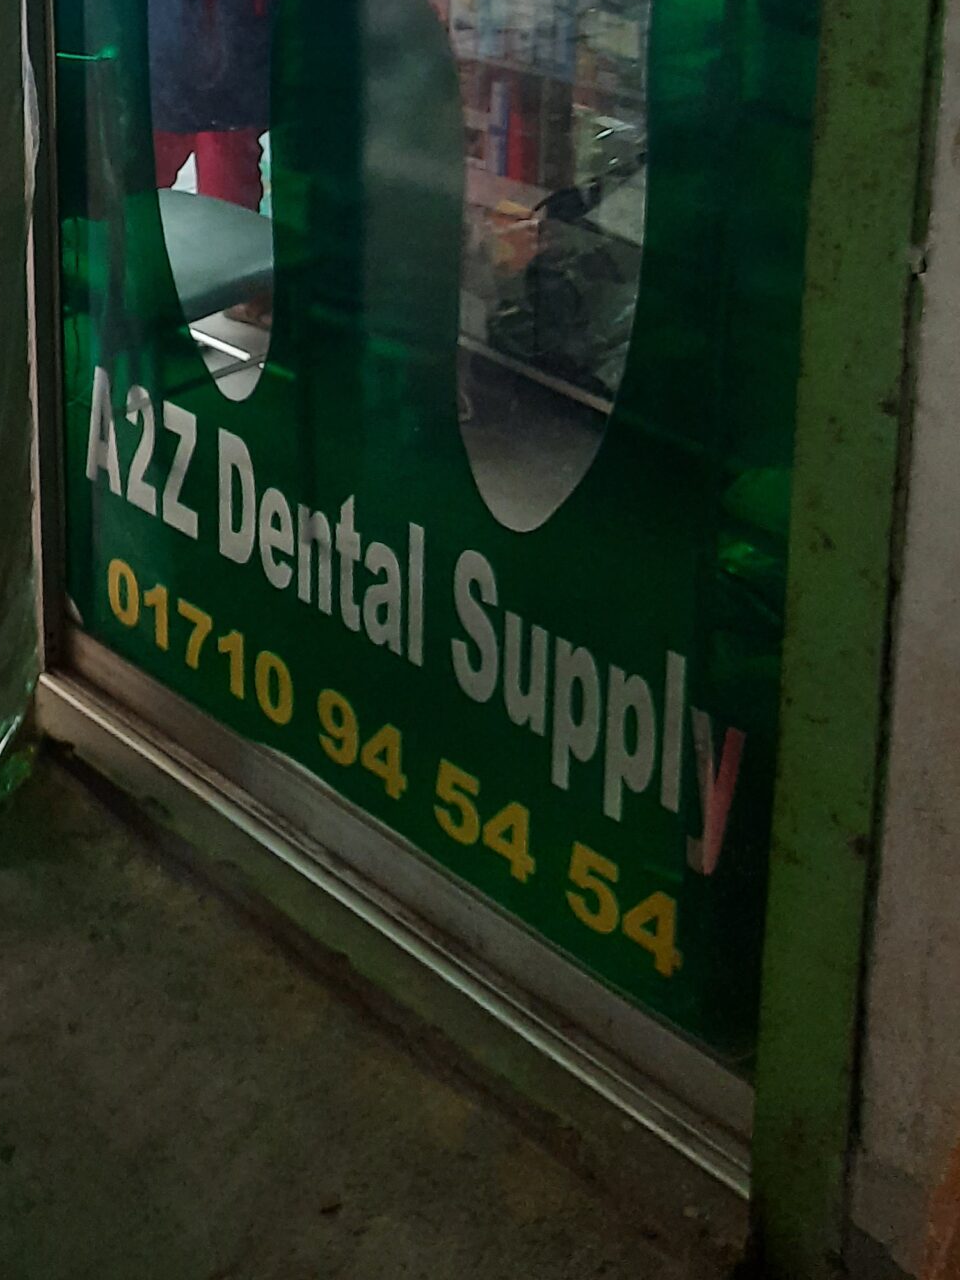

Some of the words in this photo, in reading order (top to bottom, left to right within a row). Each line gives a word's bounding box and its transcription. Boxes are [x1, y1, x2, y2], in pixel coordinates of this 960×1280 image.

[86, 365, 198, 539] A2Z
[218, 427, 426, 667] Dental
[451, 549, 746, 877] Supply
[106, 558, 294, 726] 01710
[317, 689, 408, 800] 94
[433, 758, 536, 884] 54
[566, 840, 683, 978] 54
